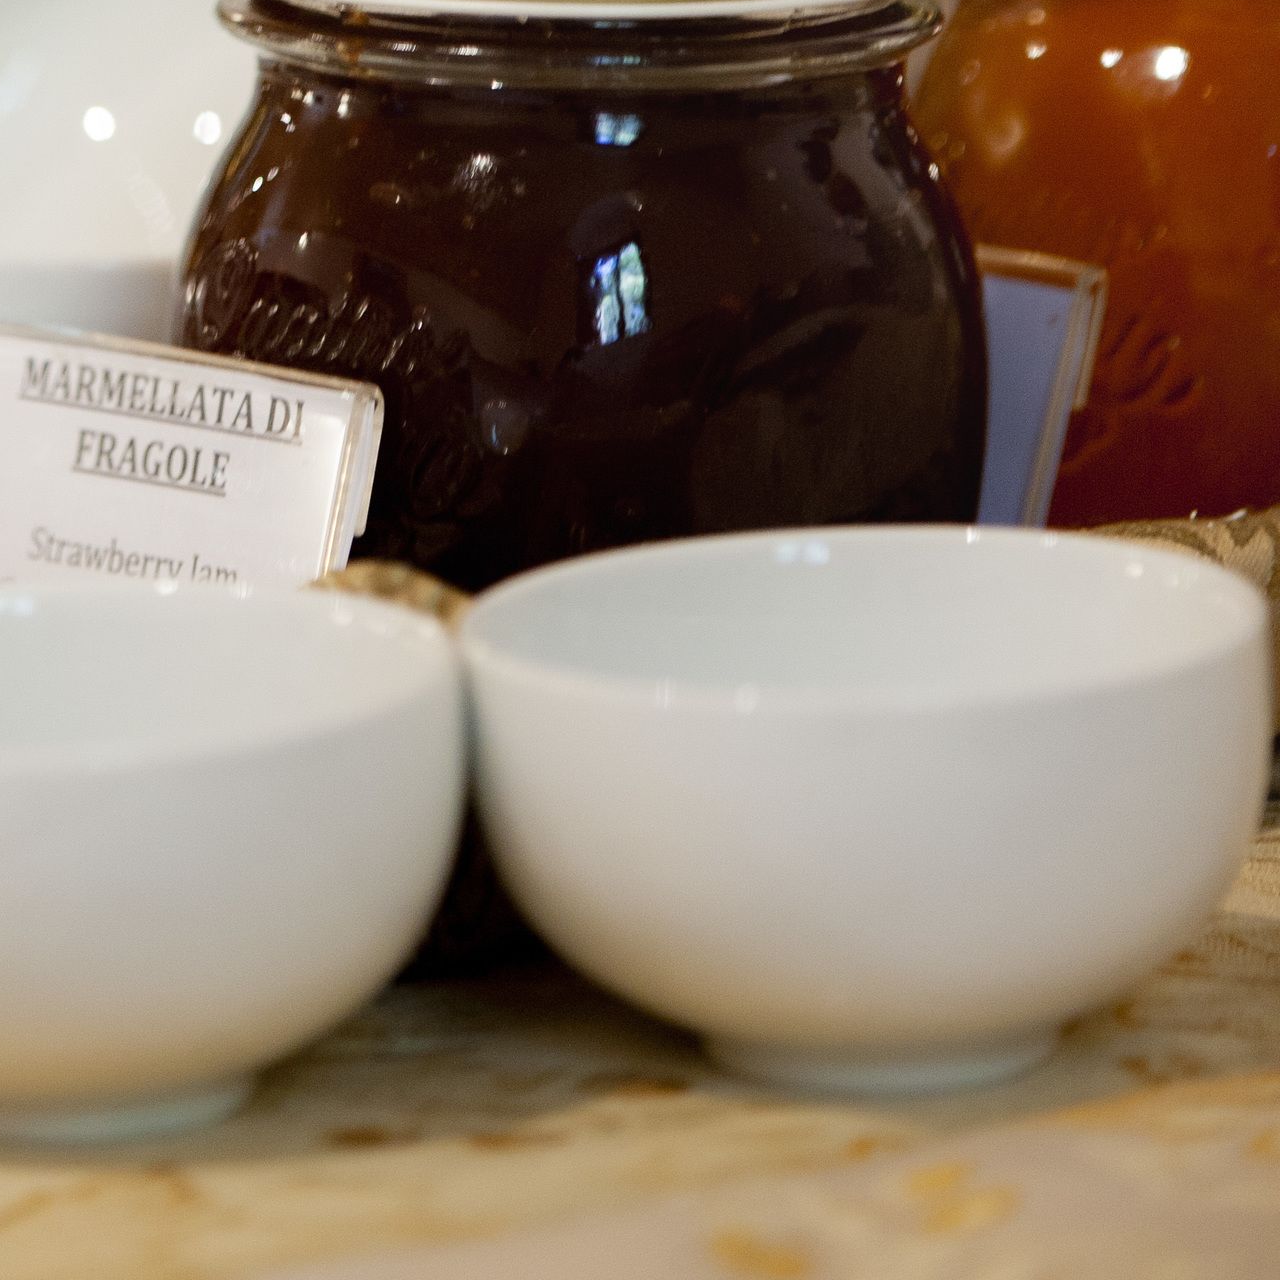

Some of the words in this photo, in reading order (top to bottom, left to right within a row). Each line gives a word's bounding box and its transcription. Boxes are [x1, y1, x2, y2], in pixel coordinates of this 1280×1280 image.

[20, 357, 255, 433] MARMELLATA
[265, 396, 305, 443] DI
[73, 428, 232, 494] FRAGOLE
[27, 525, 183, 579] Strawberry
